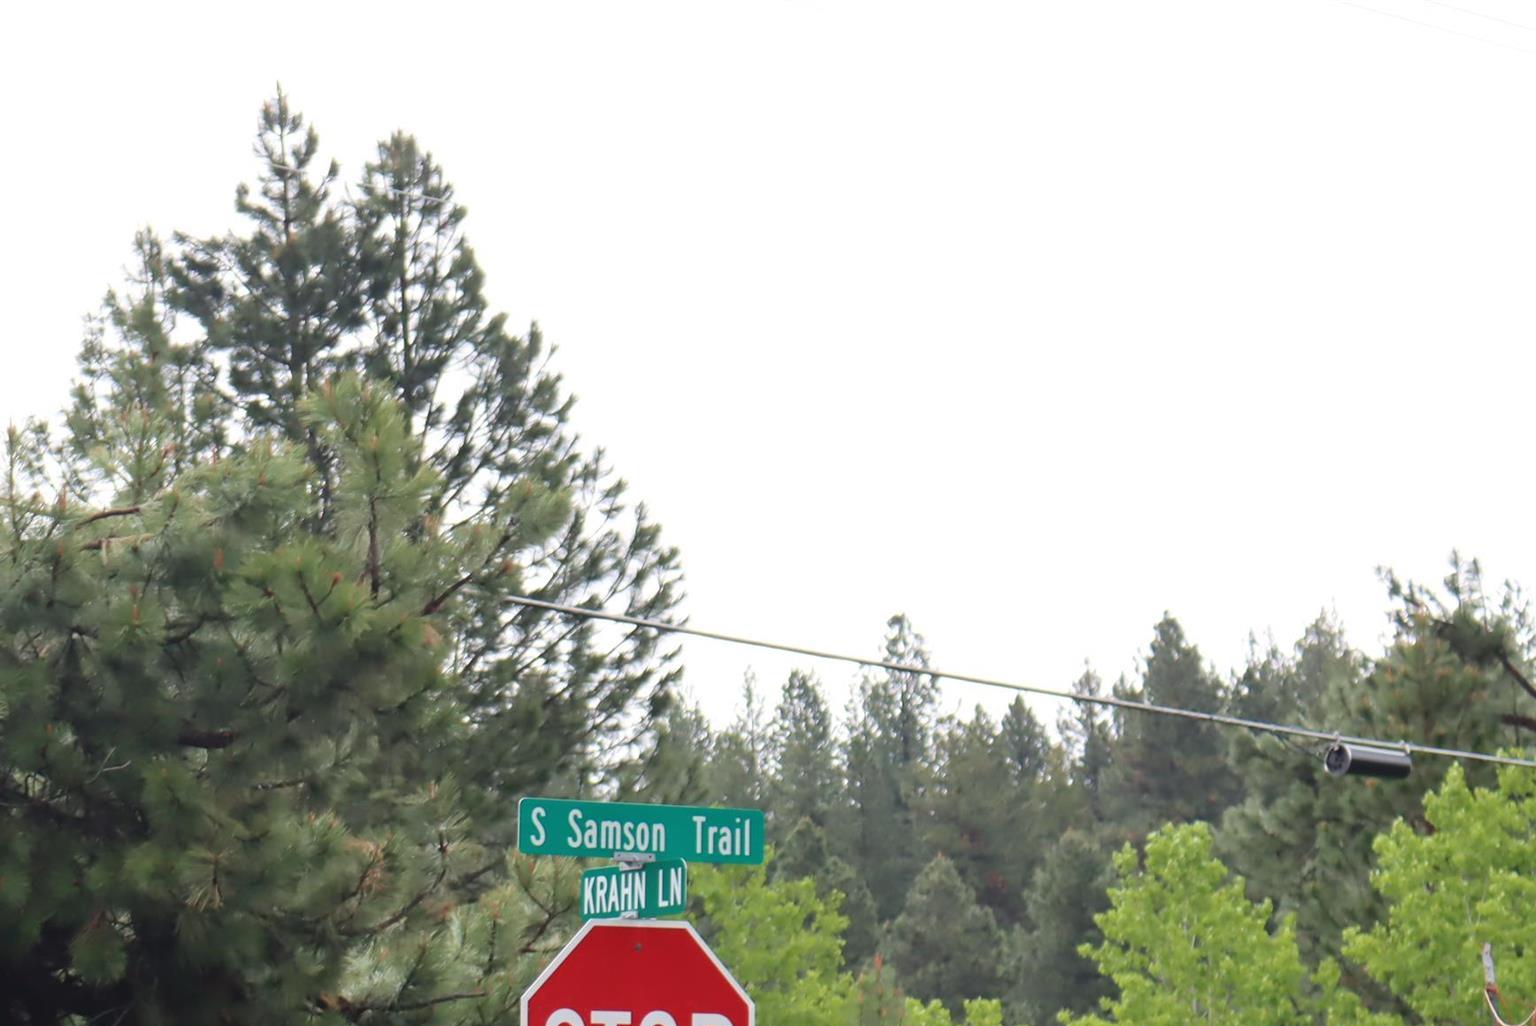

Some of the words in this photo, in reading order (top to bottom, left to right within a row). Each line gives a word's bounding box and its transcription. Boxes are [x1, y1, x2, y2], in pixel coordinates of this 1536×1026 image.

[530, 806, 547, 847] S
[567, 808, 666, 852] Samson
[692, 815, 751, 857] Trail
[583, 869, 646, 914] KRAHN
[658, 866, 683, 908] LN
